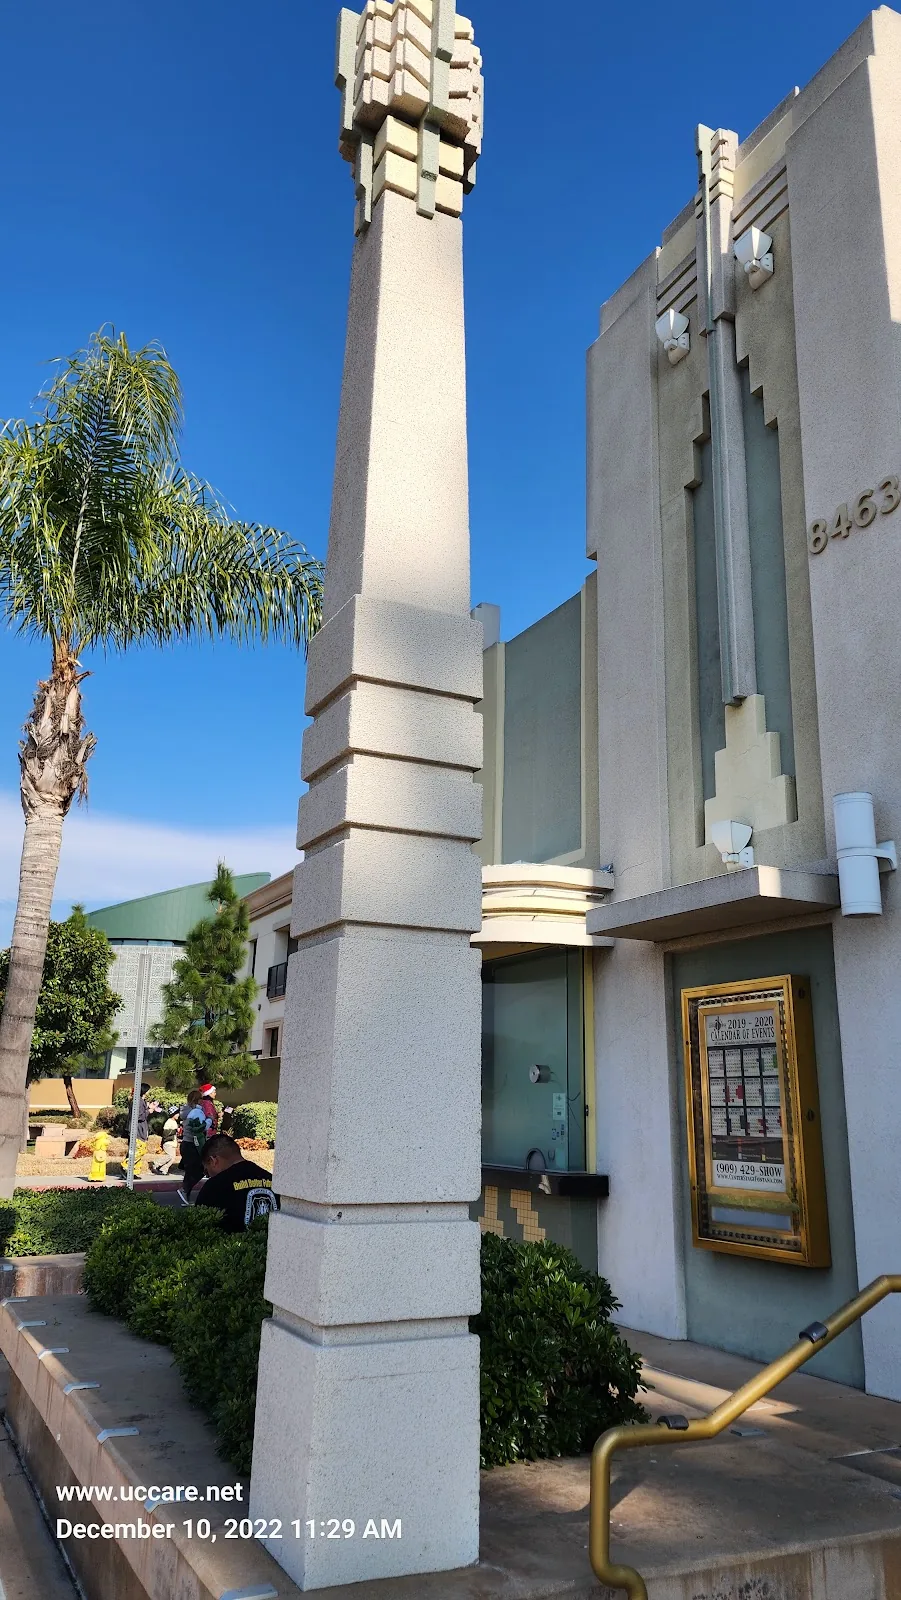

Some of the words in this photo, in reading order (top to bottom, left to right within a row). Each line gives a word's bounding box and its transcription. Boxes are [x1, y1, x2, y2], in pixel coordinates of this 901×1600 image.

[808, 475, 900, 554] 8463
[728, 1018, 746, 1029] 2019
[755, 1016, 774, 1027] 2020
[710, 1029, 741, 1041] CALENDAR
[743, 1028, 750, 1039] OF
[752, 1027, 775, 1039] EVENTS
[716, 1162, 738, 1174] (909)
[740, 1165, 782, 1177] 429-SHOW
